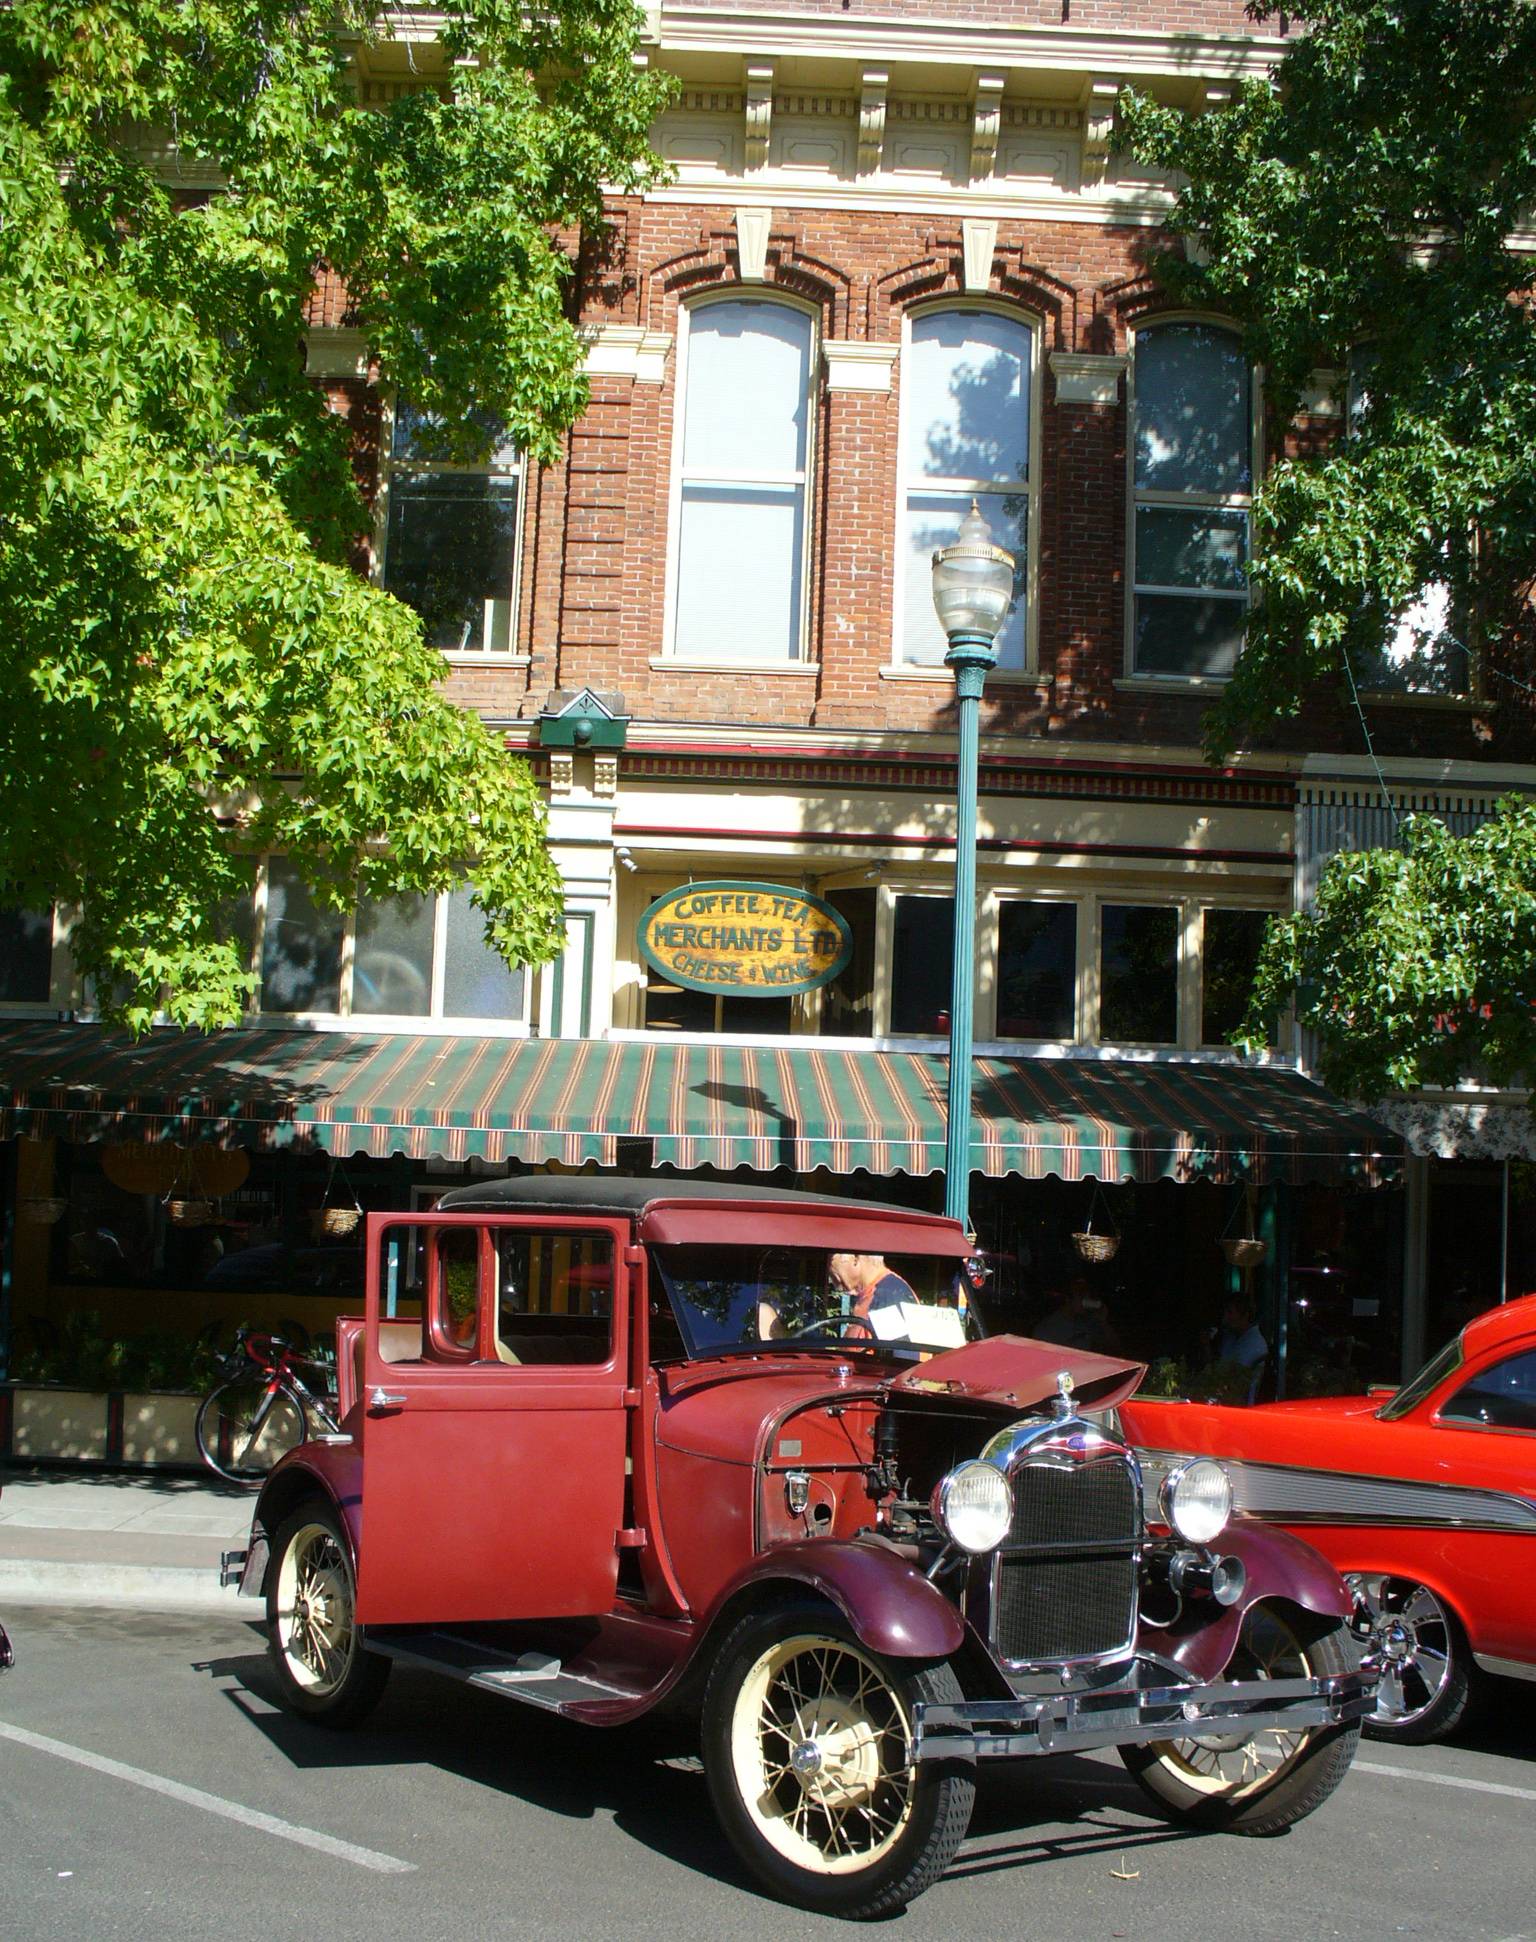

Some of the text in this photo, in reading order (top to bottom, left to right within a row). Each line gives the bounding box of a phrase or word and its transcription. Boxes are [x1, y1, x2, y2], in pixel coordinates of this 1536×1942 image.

[772, 896, 811, 926] TEA
[654, 922, 783, 952] MERCHANTS
[672, 951, 743, 982] CHEESE
[761, 959, 816, 984] WINE
